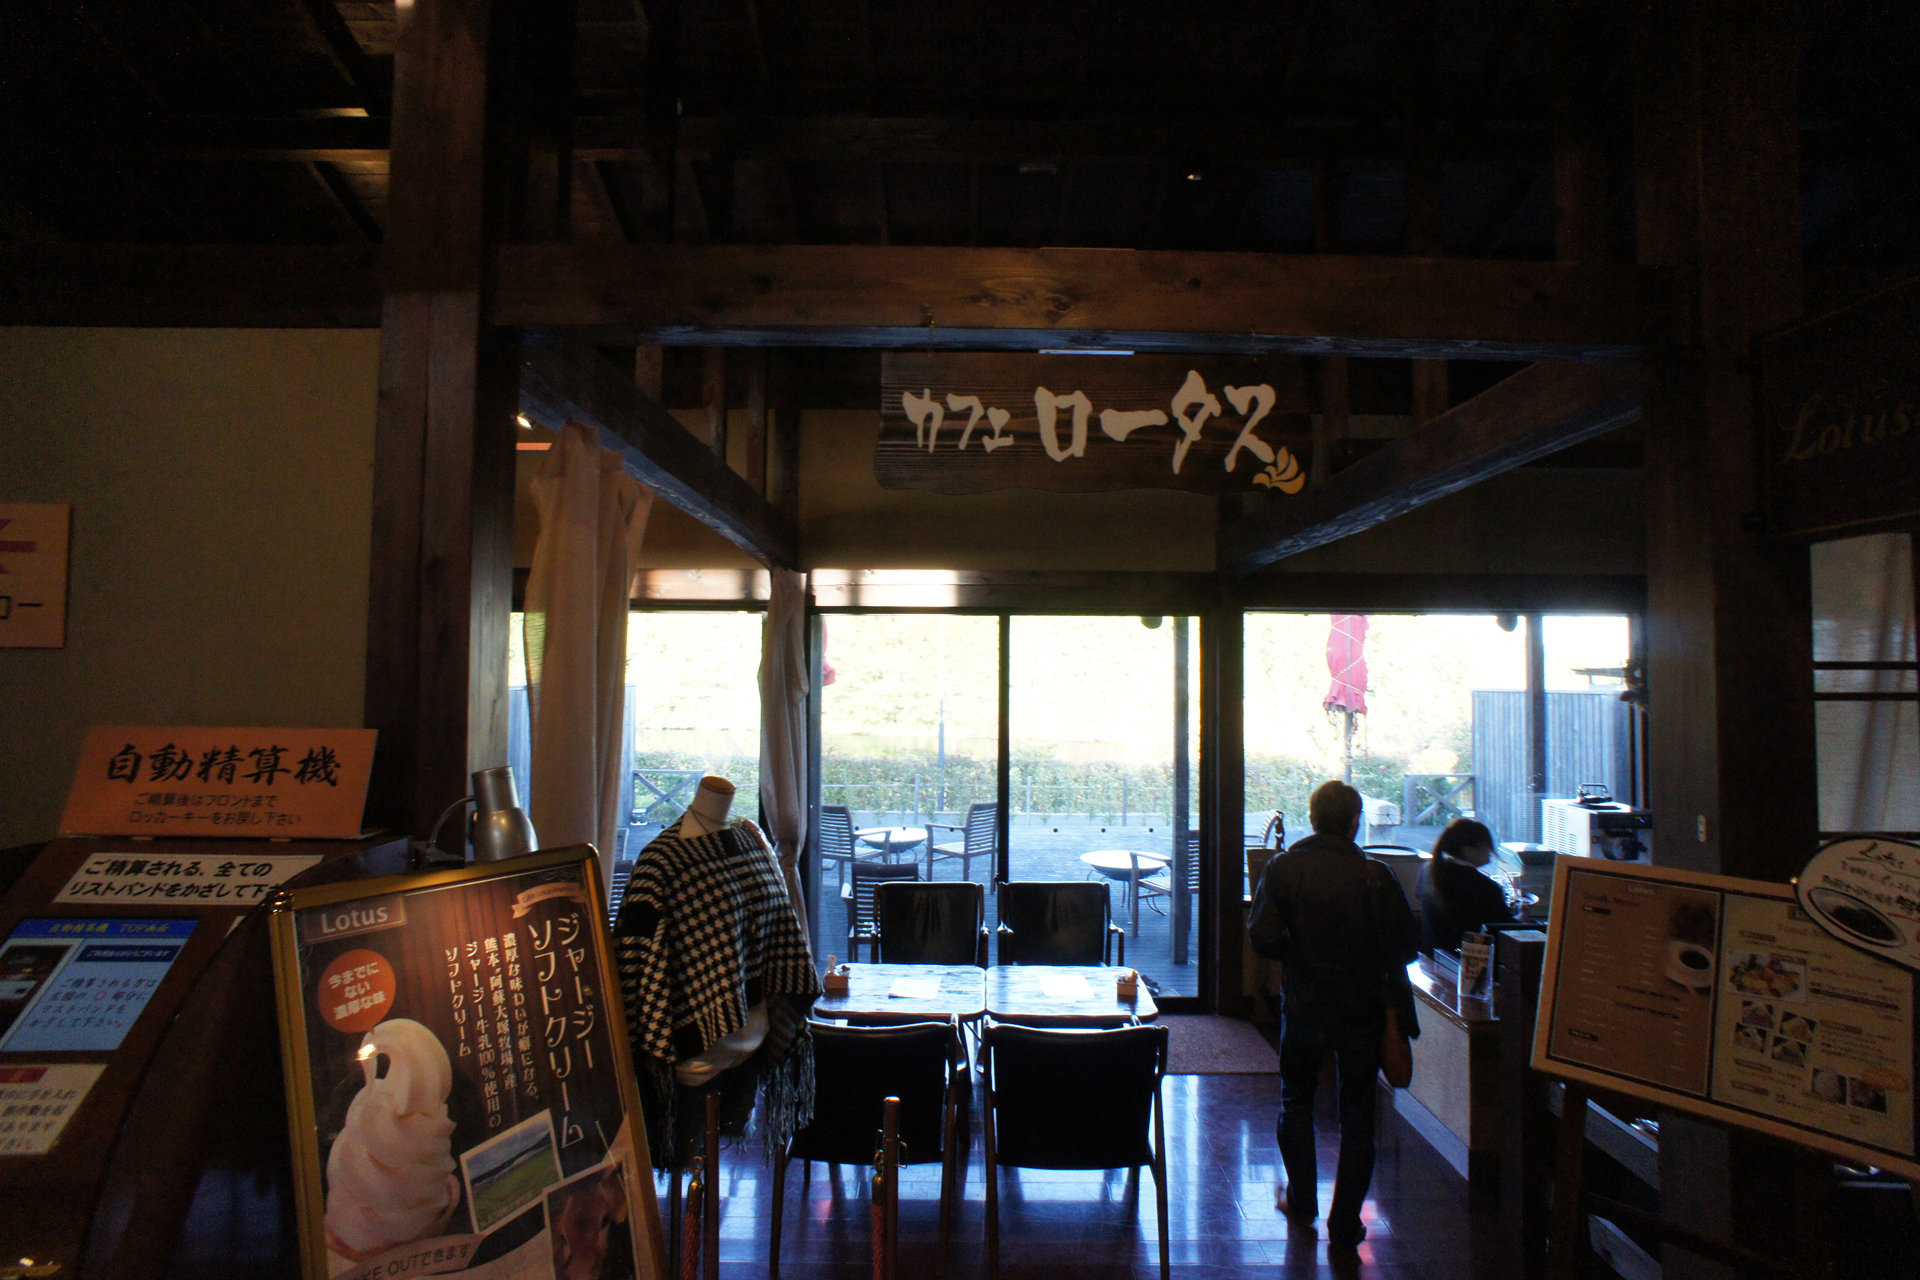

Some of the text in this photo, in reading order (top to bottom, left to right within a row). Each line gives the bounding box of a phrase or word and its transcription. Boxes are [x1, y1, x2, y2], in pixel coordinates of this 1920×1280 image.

[902, 369, 1277, 475] カフェ ロータス
[107, 743, 341, 787] 自動精算機
[321, 906, 389, 934] Lotus
[327, 961, 381, 990] 今までに
[343, 980, 372, 999] ない
[445, 946, 472, 1058] ソフトクリーム
[557, 912, 595, 1070] ジャージー
[528, 919, 585, 1149] ソフトクリーム
